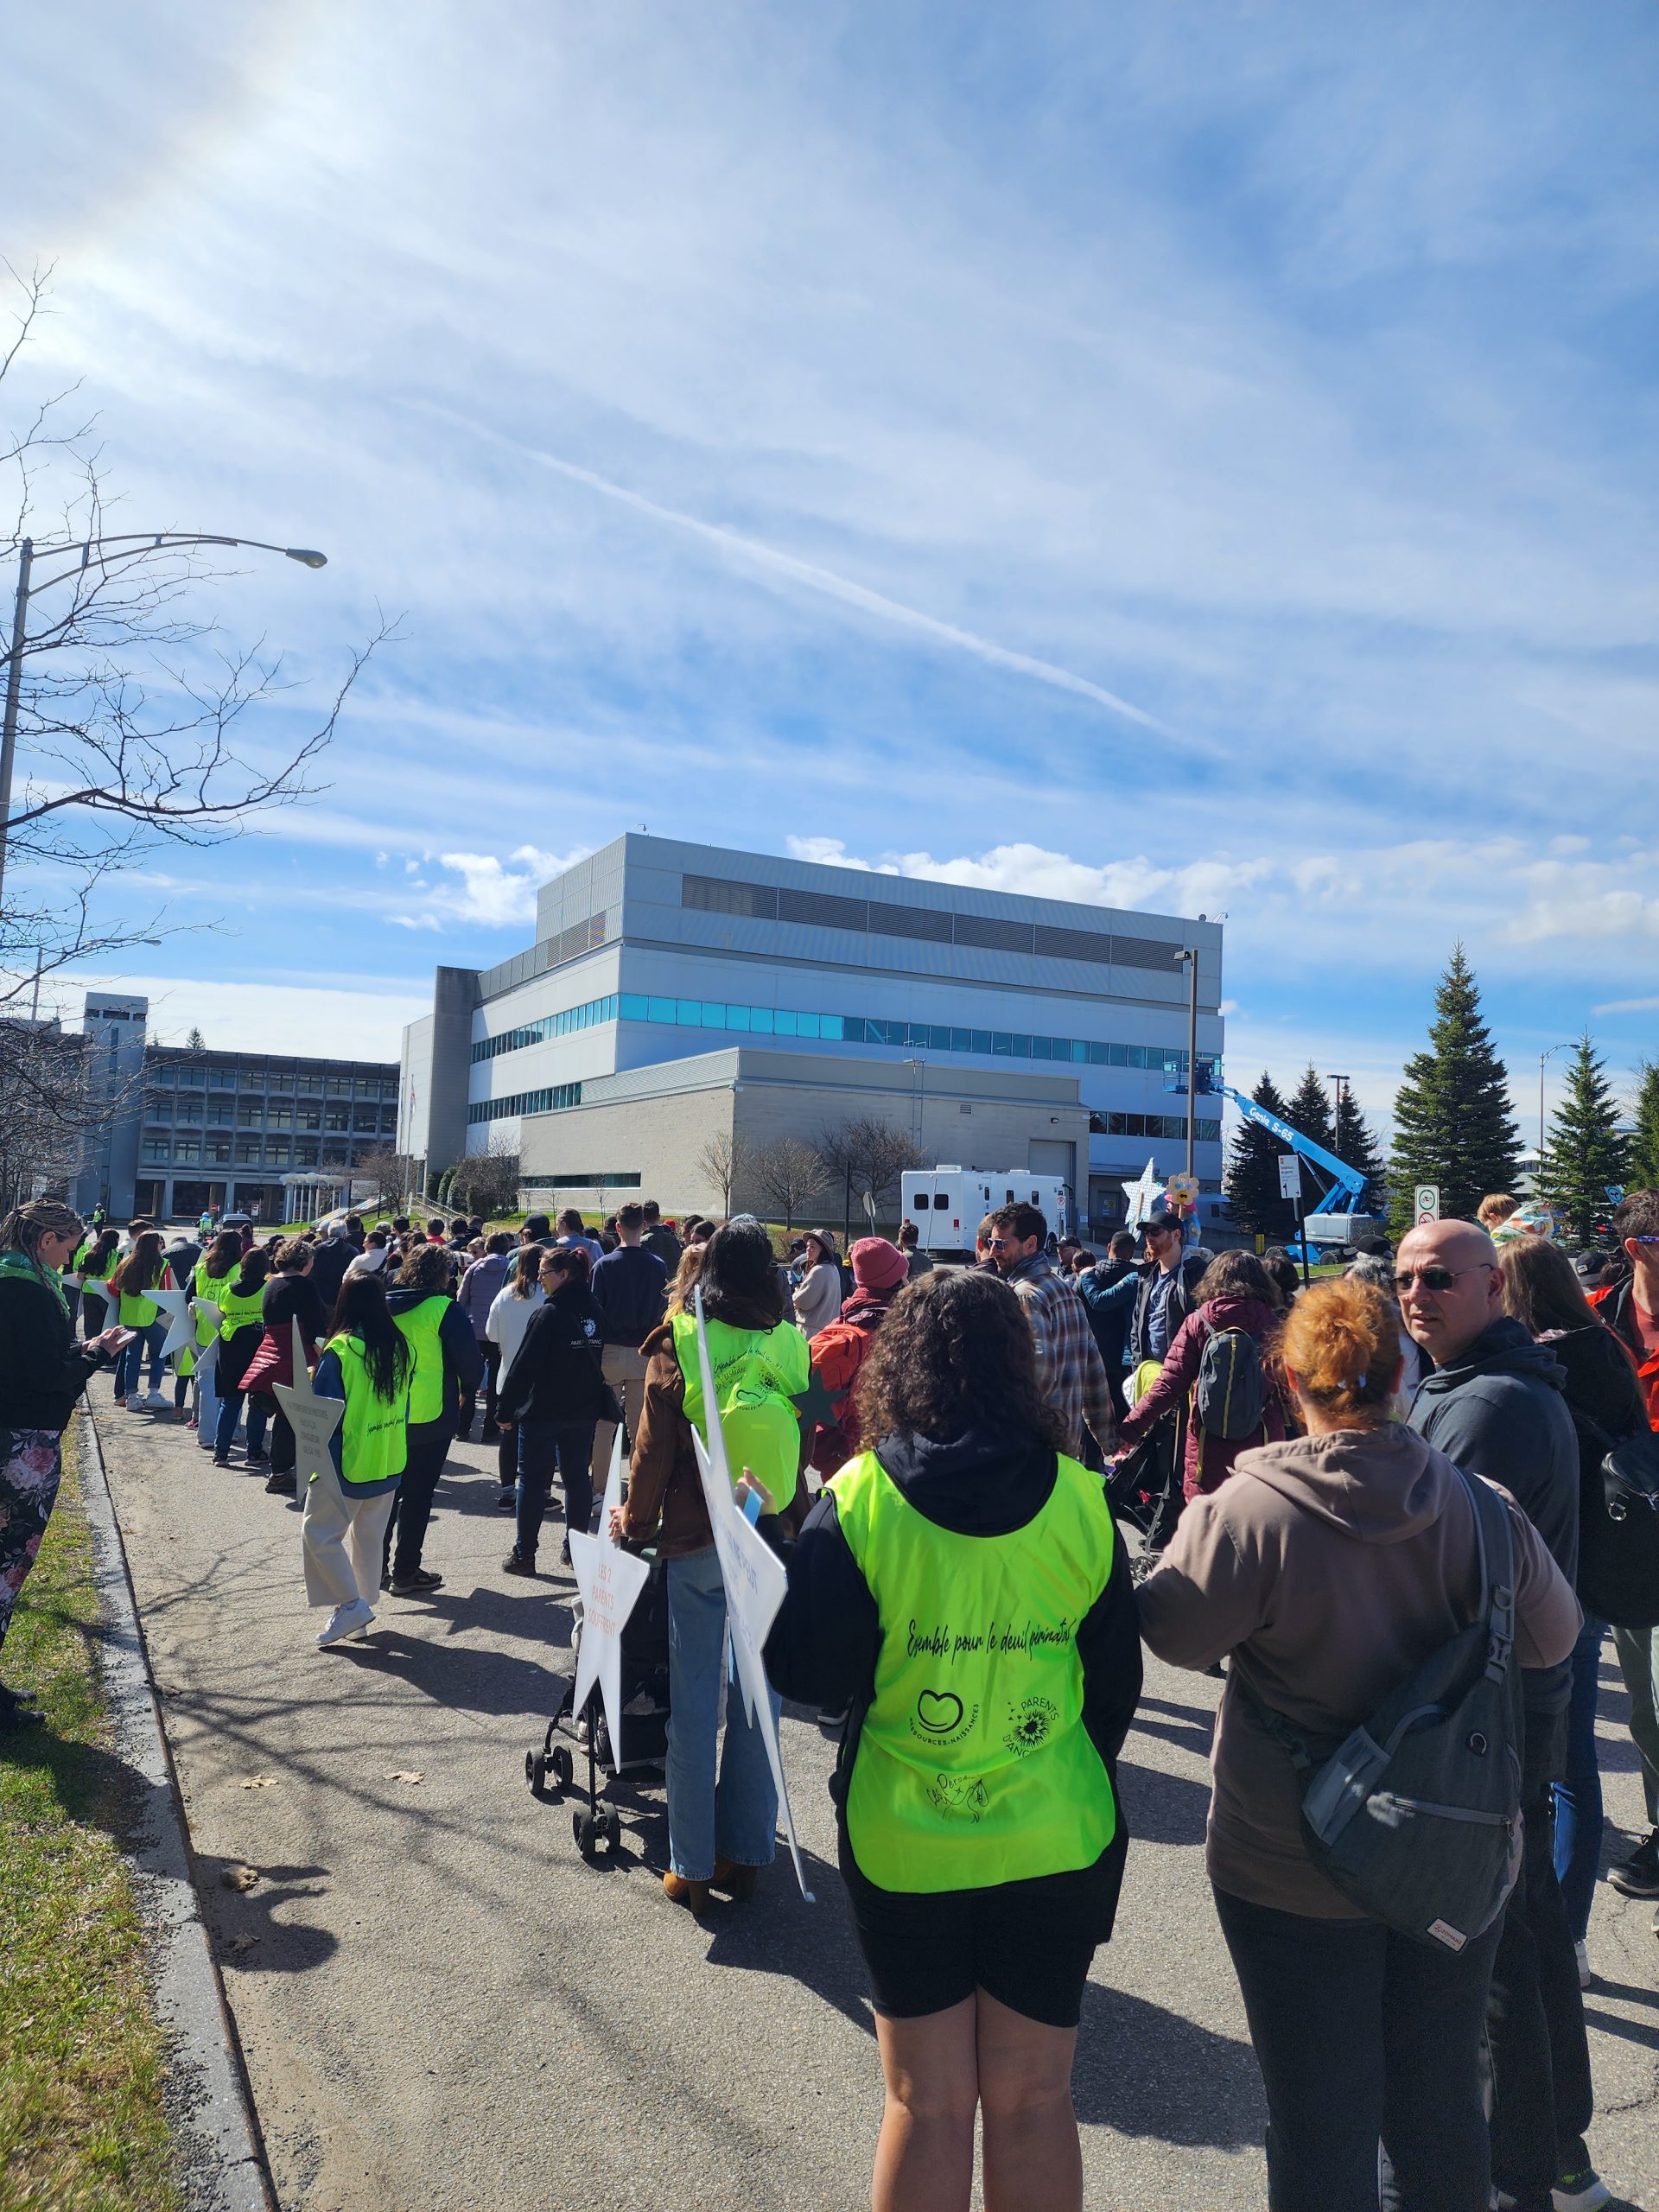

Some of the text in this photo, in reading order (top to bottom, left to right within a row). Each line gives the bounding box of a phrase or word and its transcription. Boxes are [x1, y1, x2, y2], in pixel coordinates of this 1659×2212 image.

[1249, 1107, 1294, 1141] Genie S-65
[1283, 1183, 1287, 1198] 1
[607, 1567, 612, 1583] 2
[592, 1585, 613, 1611] PARENTS
[588, 1608, 616, 1638] SOUFFRENT
[951, 1633, 984, 1666] pour
[986, 1621, 997, 1654] le
[1001, 1620, 1031, 1656] deuil
[1021, 1696, 1059, 1720] PARENTS
